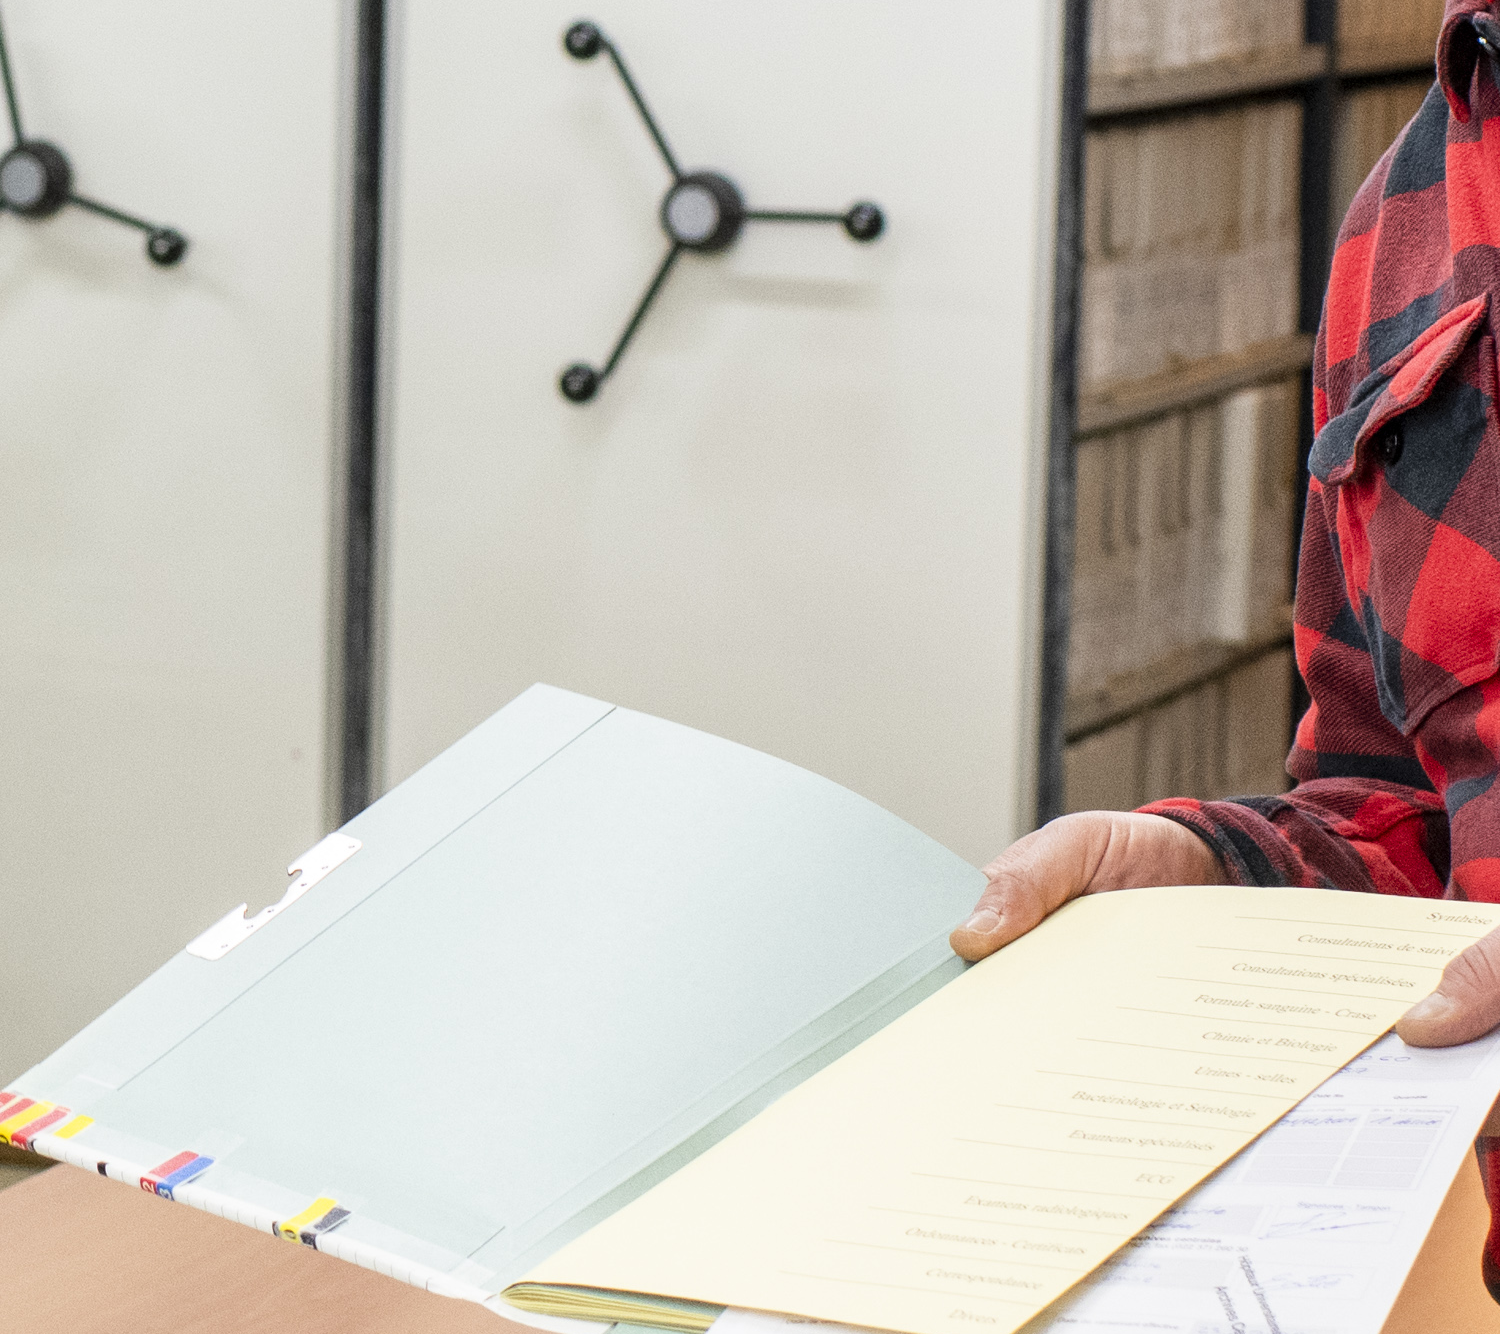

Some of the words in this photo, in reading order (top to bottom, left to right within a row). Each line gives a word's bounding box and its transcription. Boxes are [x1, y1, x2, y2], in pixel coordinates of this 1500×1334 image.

[1426, 911, 1493, 926] Synthèse
[1297, 933, 1395, 951] Consultations
[1396, 941, 1415, 951] de
[1231, 962, 1328, 980] Consultations
[1329, 968, 1417, 989] spécialisées
[1194, 994, 1255, 1009] Formule
[1257, 1000, 1322, 1015] sanguine
[1334, 1007, 1377, 1021] Crase
[1201, 1030, 1256, 1044] Chimie
[1259, 1036, 1276, 1046] et
[1278, 1036, 1338, 1053] Biologie
[1194, 1066, 1241, 1079] Urines
[1255, 1072, 1298, 1085] selles
[1071, 1090, 1167, 1111] Bactériologie
[1168, 1101, 1185, 1111] et
[1186, 1101, 1257, 1119] Sérologie
[1068, 1129, 1132, 1145] Examens
[1135, 1173, 1175, 1185] ECG
[1214, 1286, 1240, 1322] Archives
